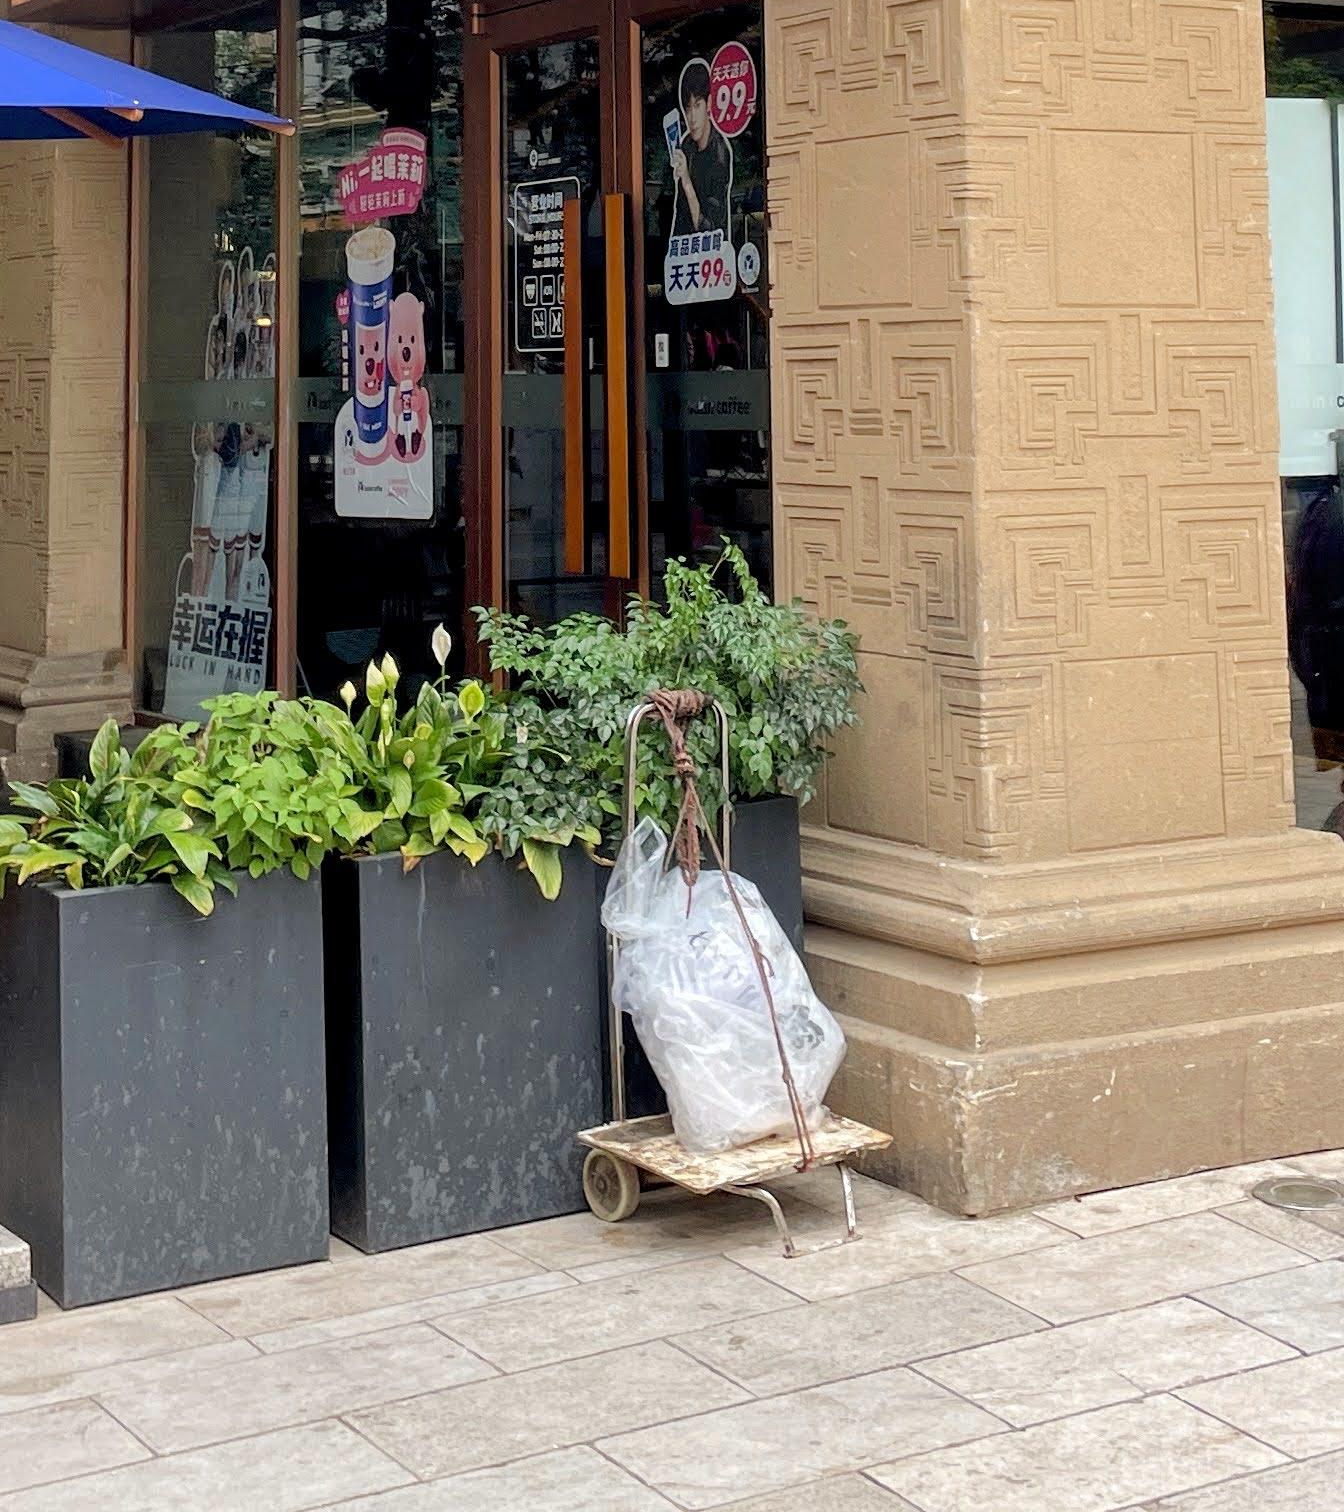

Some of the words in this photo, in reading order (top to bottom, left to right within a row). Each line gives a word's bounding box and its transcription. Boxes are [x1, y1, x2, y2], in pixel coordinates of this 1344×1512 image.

[170, 597, 270, 666] 幸运在握
[169, 655, 195, 670] LUCK
[203, 659, 217, 677] IN
[226, 665, 262, 686] HAND
